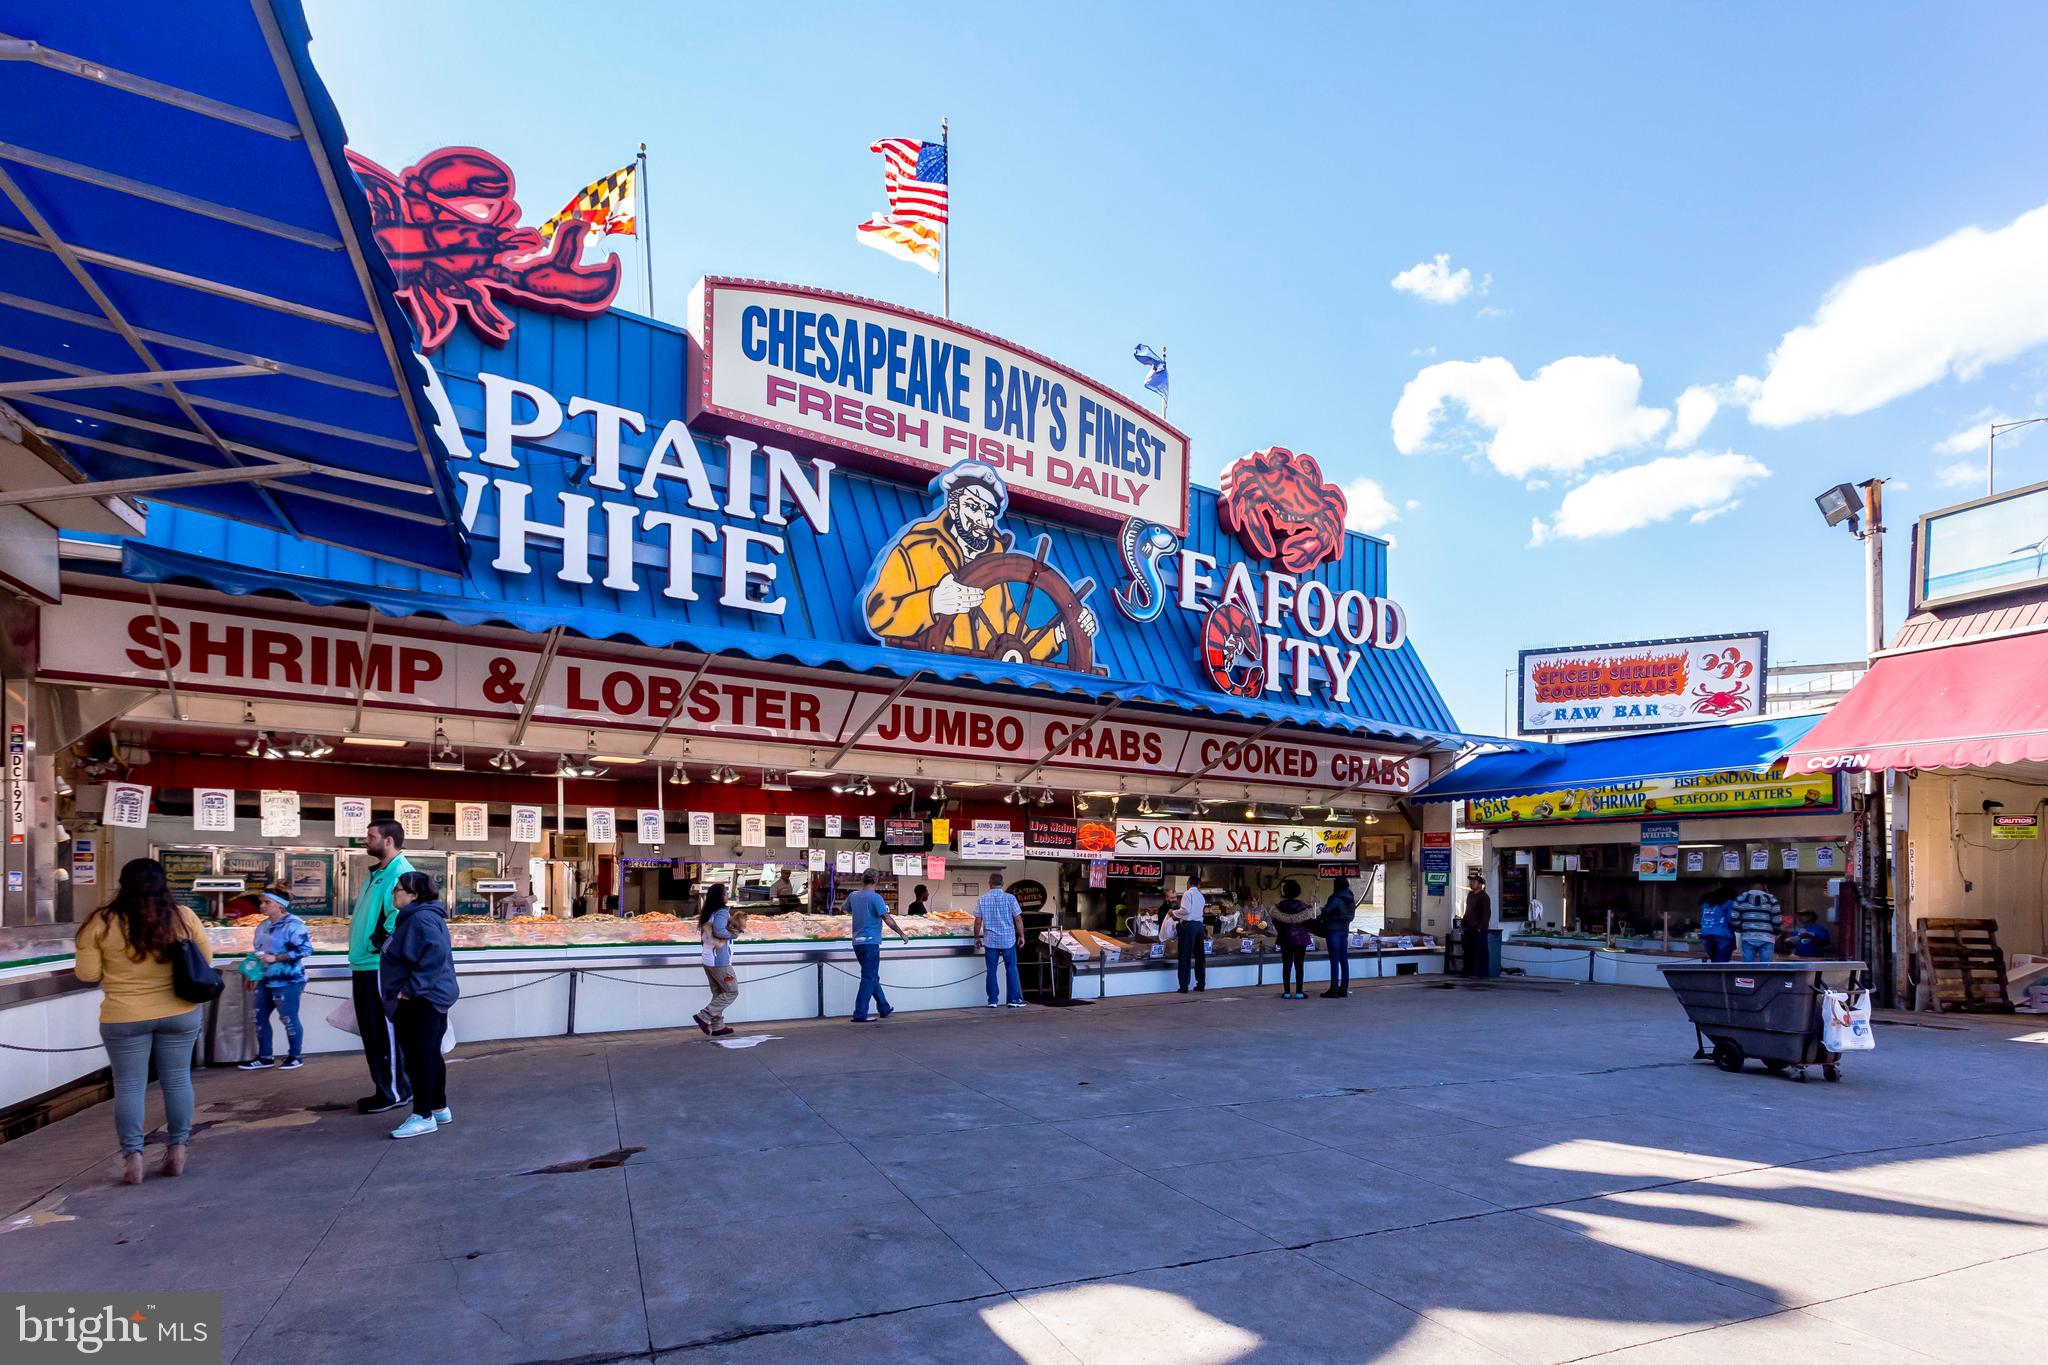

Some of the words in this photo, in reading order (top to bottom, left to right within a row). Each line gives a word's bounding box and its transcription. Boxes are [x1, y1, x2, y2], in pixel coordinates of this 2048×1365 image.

[741, 305, 970, 422] CHESAPEAKE
[984, 358, 1067, 452] BAY'S
[1079, 394, 1166, 481] FINEST
[767, 375, 928, 449] FRESH
[942, 427, 1034, 477] FISH
[1047, 456, 1149, 506] DAILY
[125, 614, 443, 695] SHRIMP
[482, 657, 525, 704] &
[567, 666, 821, 733] LOBSTER
[1539, 668, 1602, 685] SPICED
[1609, 662, 1679, 681] SHRIMP
[1539, 683, 1611, 700] COOKED
[1618, 678, 1679, 696] CRABS
[1553, 704, 1603, 721] RAW
[1614, 703, 1661, 719] BAR
[877, 703, 1025, 751] JUMBO
[1044, 721, 1163, 765] CRABS
[1200, 738, 1318, 778] COOKED
[1331, 752, 1410, 793] CRABS
[1806, 753, 1871, 769] CORN
[1674, 776, 1700, 788] FISH
[1592, 792, 1647, 811] SHRIMP
[1673, 792, 1728, 805] SEAFOOD
[1734, 787, 1793, 801] PLATTERS
[1484, 799, 1511, 819] BAR
[1029, 820, 1049, 831] Live
[1050, 822, 1077, 833] Maine
[1033, 833, 1073, 845] Lobsters
[1153, 826, 1215, 851] CRAB
[1226, 829, 1280, 853] SALE
[229, 860, 270, 872] SHRIMP
[1108, 863, 1129, 875] Live
[1133, 863, 1161, 876] Crabs
